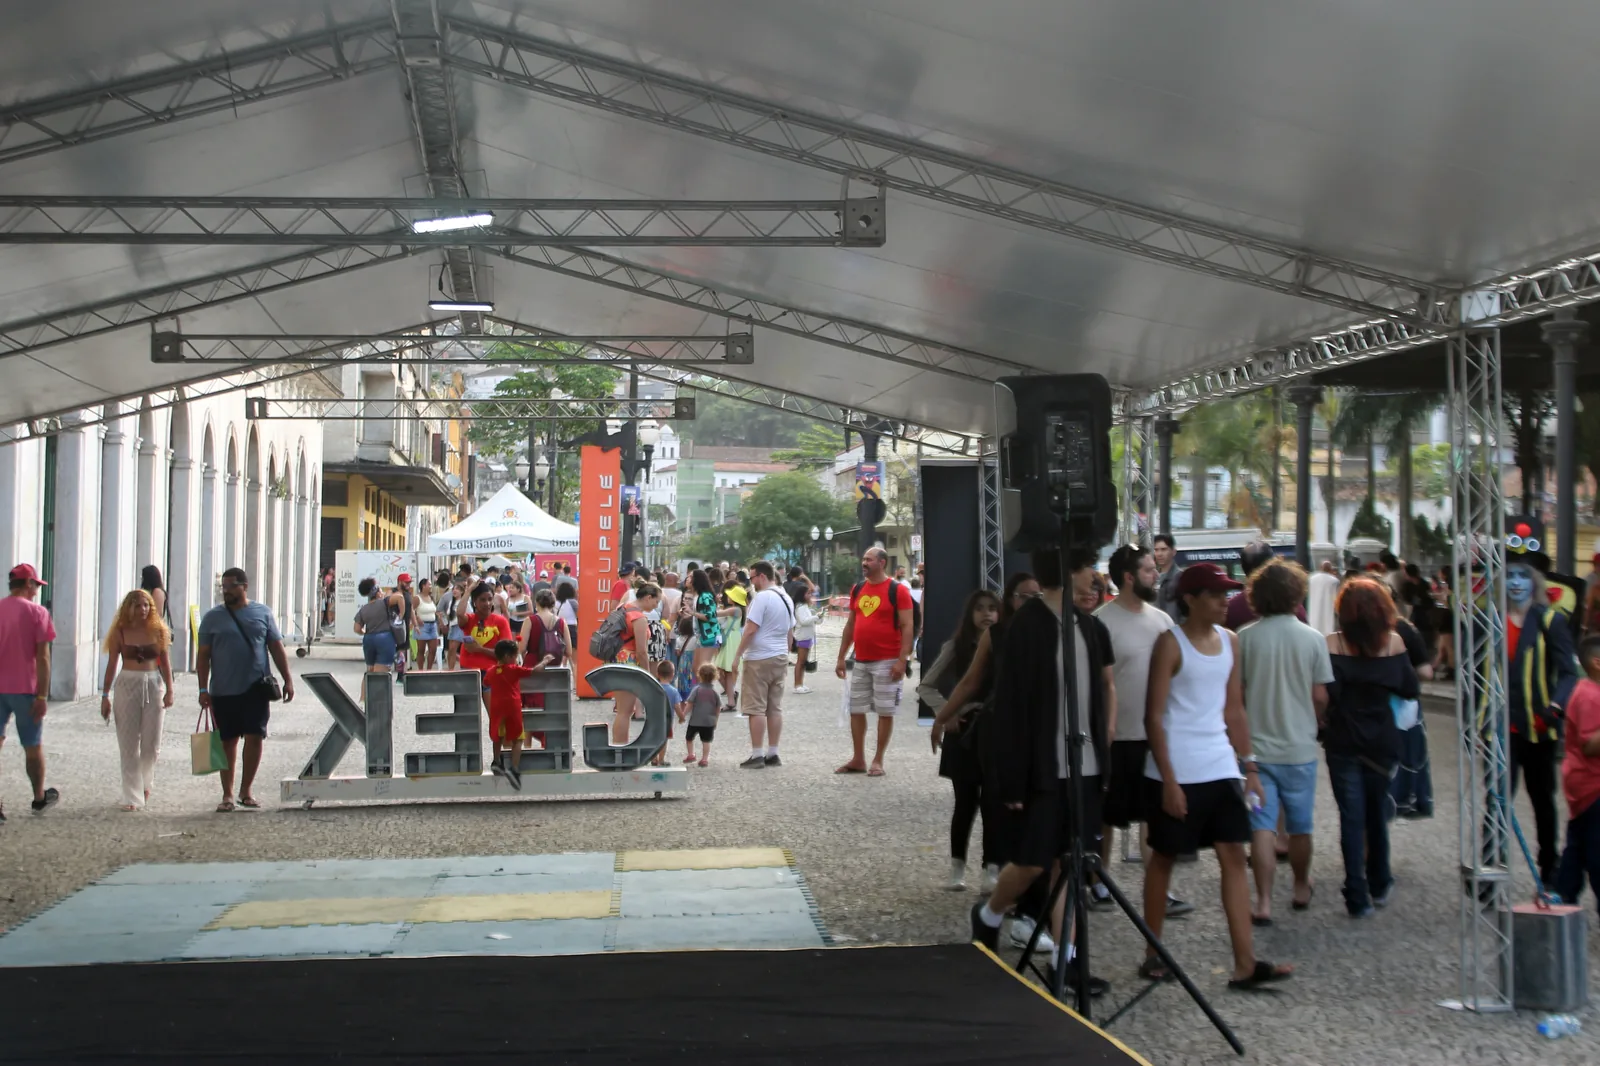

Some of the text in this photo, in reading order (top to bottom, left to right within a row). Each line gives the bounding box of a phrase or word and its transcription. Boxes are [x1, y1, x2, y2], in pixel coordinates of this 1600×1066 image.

[490, 520, 534, 528] Santos
[475, 538, 513, 549] Santos
[337, 578, 355, 587] Santos
[863, 600, 875, 608] CH
